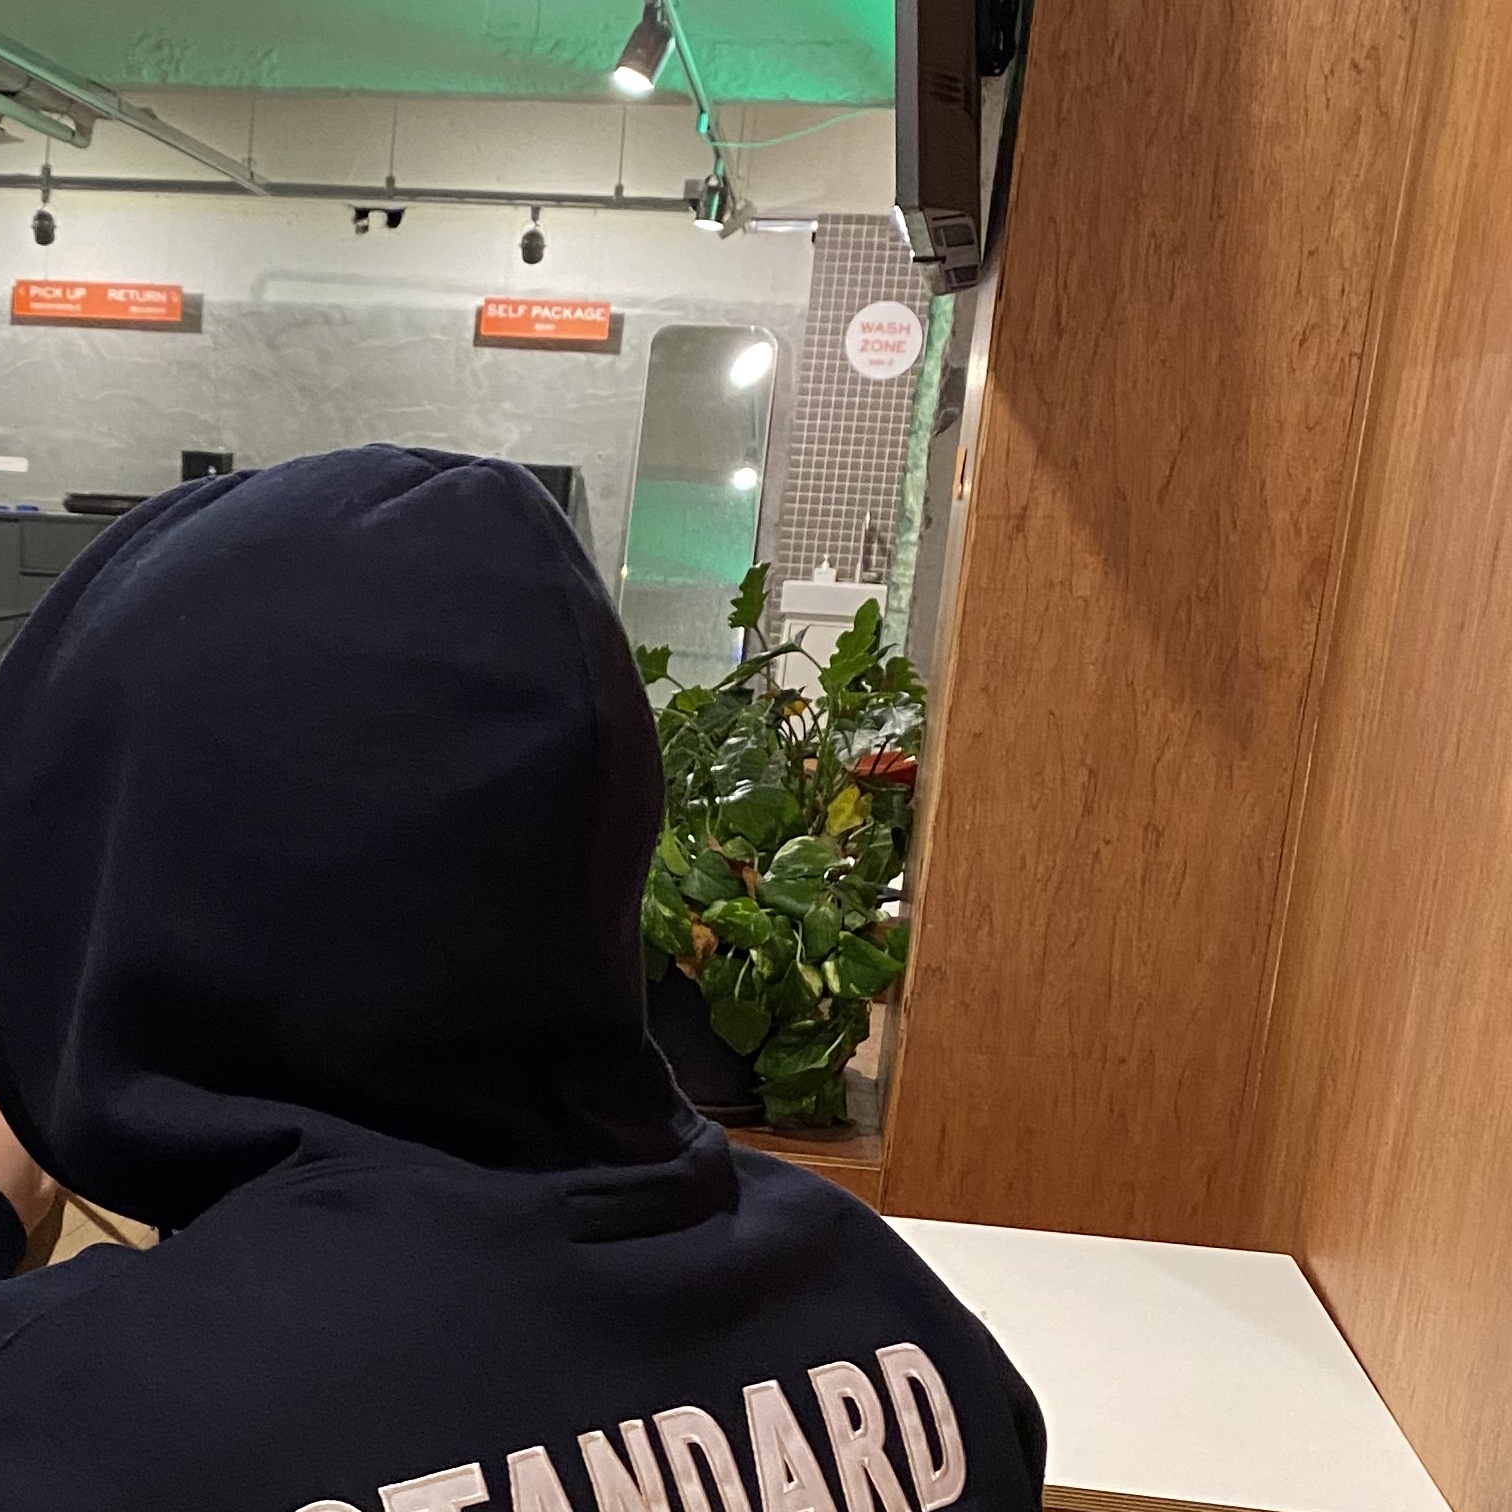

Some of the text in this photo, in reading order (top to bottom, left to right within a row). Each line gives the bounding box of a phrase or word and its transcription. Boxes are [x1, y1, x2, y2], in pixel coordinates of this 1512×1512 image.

[29, 285, 87, 299] PICK UP
[107, 288, 167, 303] RETURN
[487, 303, 606, 321] SELF PACKAGE
[860, 321, 911, 336] WASH
[859, 339, 907, 353] ZONE
